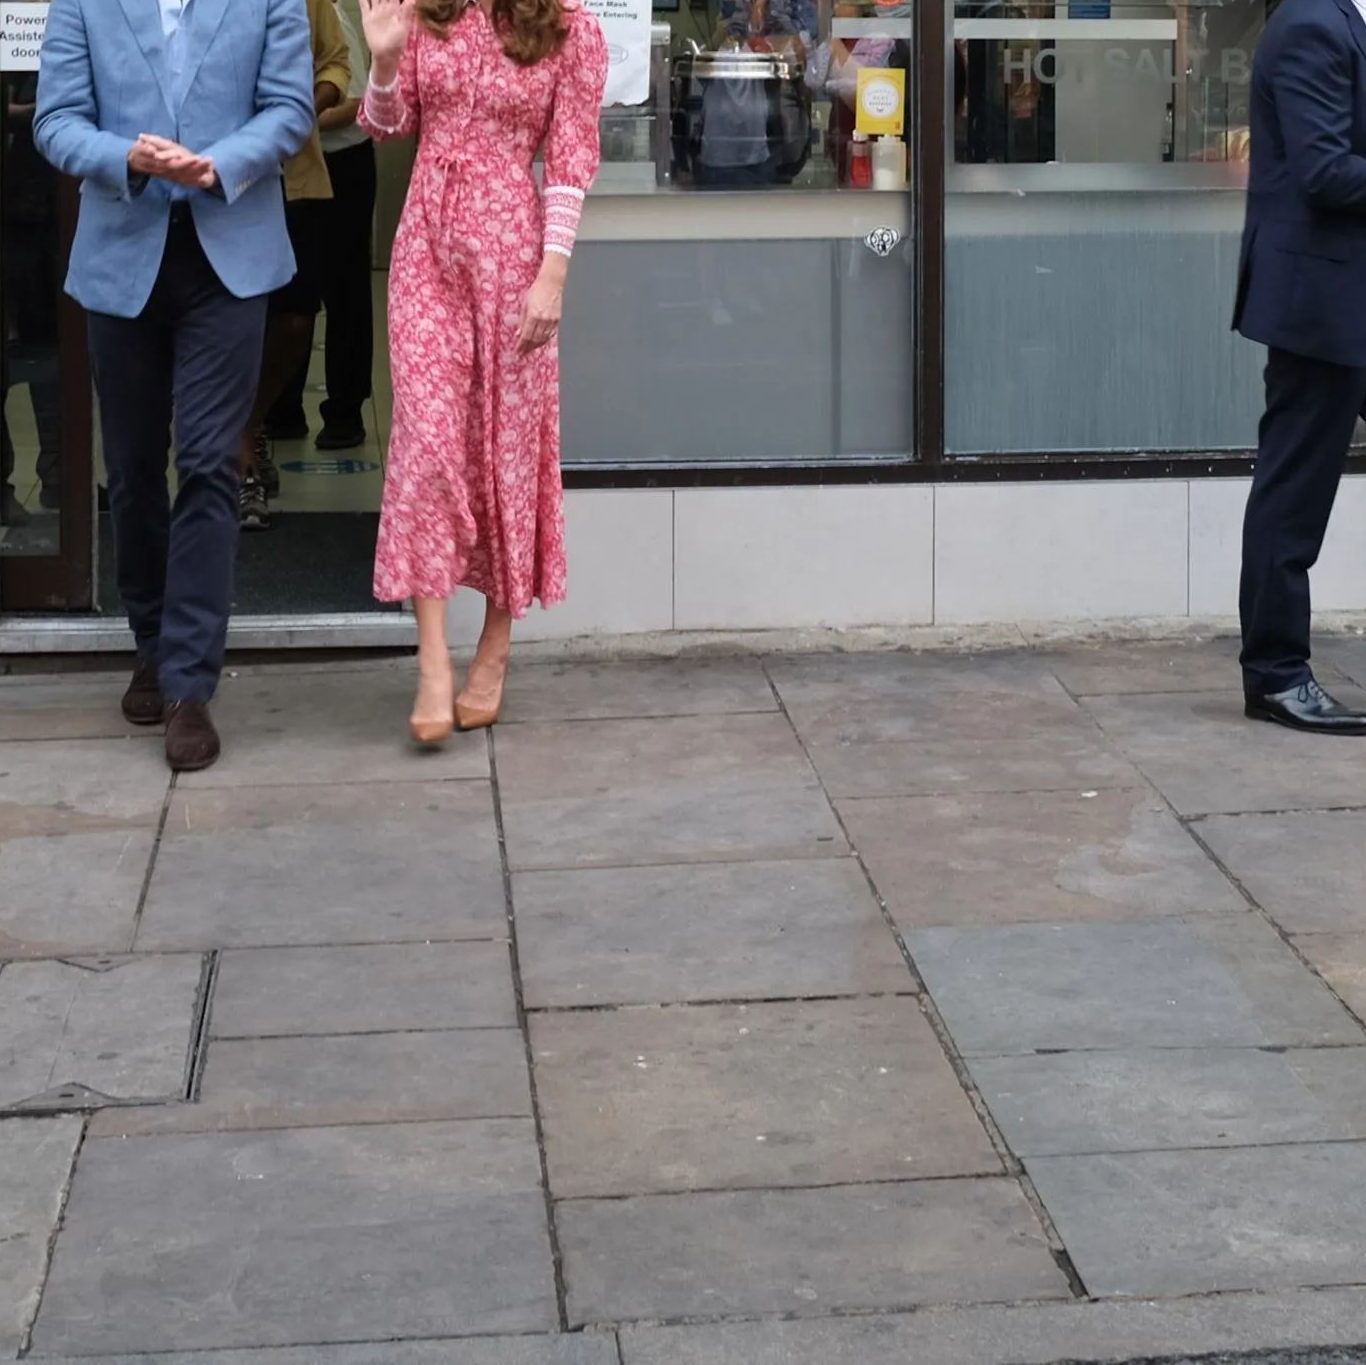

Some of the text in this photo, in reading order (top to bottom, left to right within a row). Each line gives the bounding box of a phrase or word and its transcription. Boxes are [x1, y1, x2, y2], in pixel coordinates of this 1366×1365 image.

[602, 11, 638, 20] Entering
[1002, 47, 1092, 85] HOT
[1103, 47, 1210, 85] SALT
